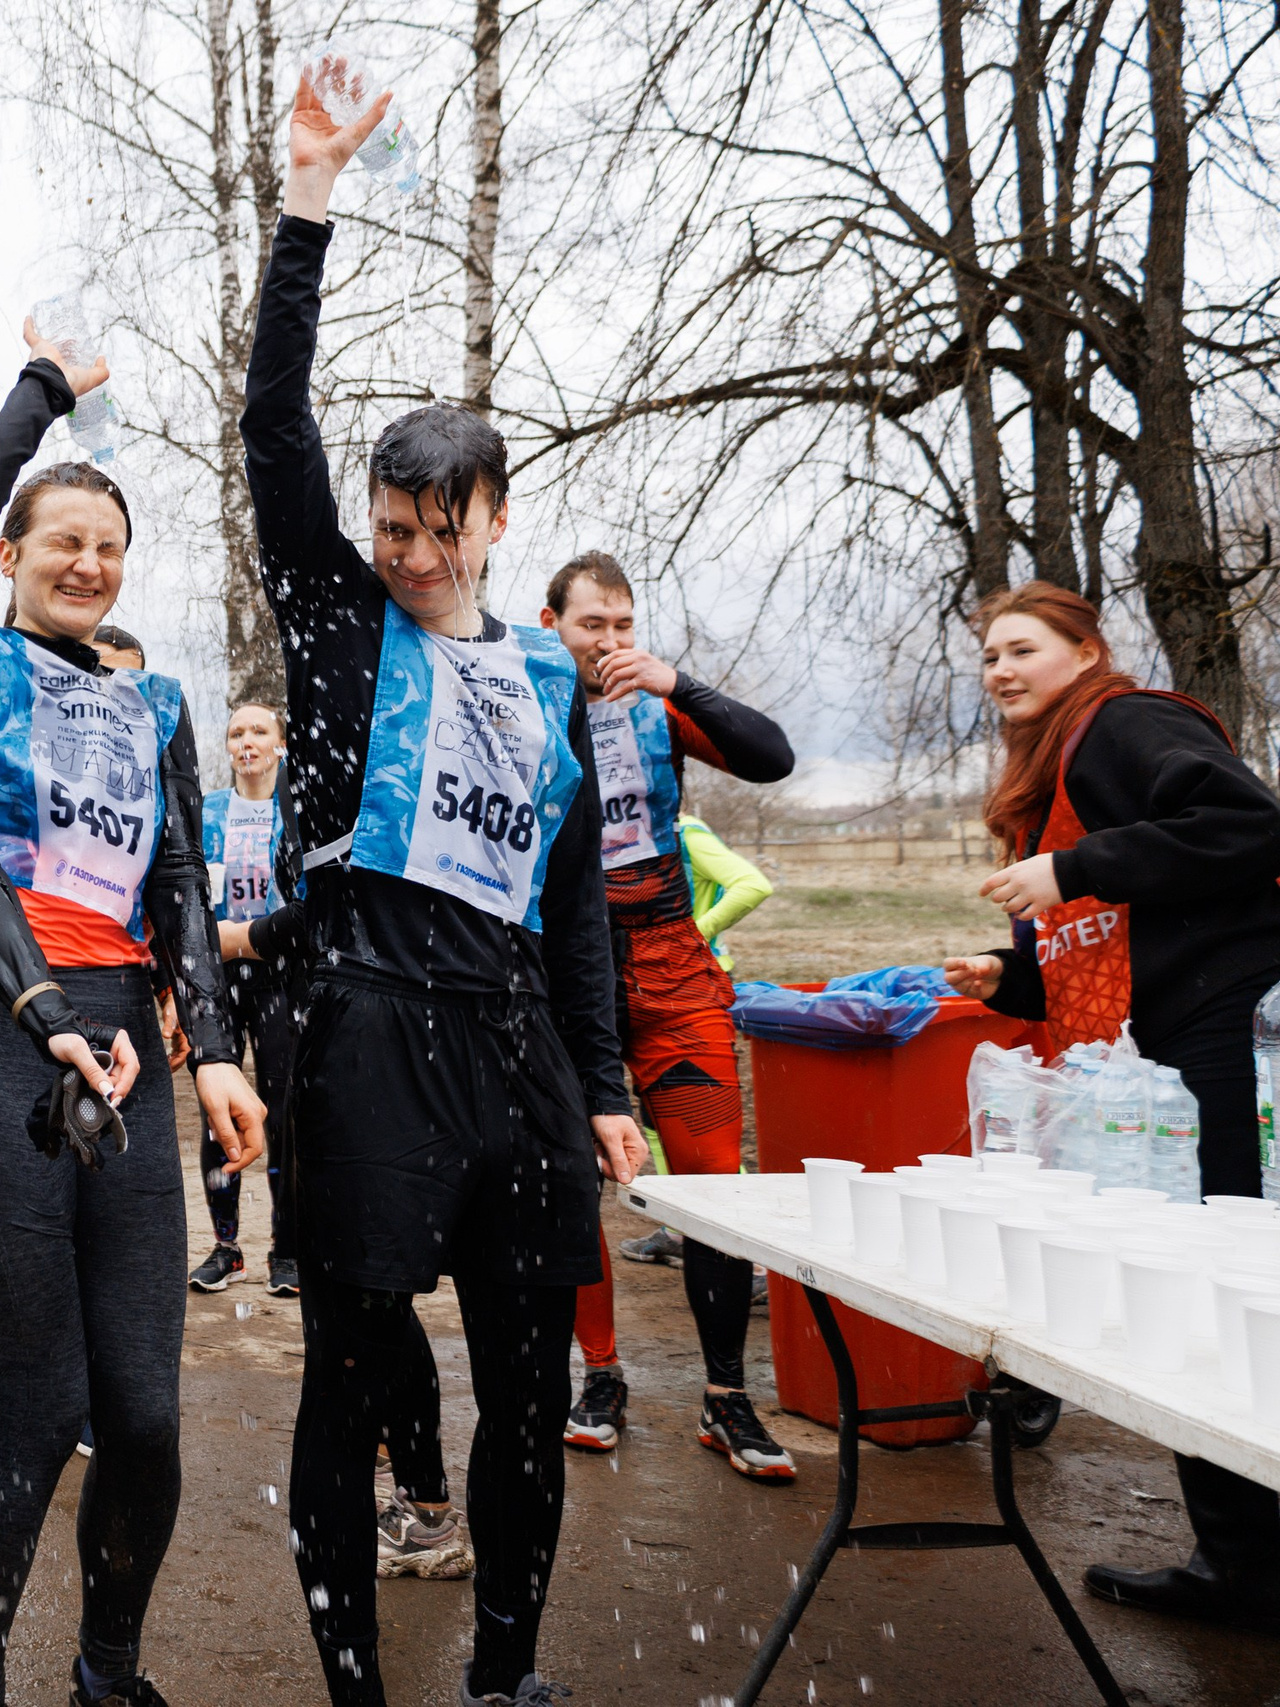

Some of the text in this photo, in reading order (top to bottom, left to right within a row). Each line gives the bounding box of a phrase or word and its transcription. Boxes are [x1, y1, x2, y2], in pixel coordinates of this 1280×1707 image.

[39, 675, 92, 689] ГОНКА
[478, 676, 529, 696] ЕРОЕВ
[56, 700, 133, 735] Sminex
[455, 710, 476, 721] FINE
[57, 735, 78, 744] FINE
[593, 736, 618, 750] nex
[50, 780, 143, 856] 5407
[230, 816, 273, 825] ГОНКА ГЕР
[432, 770, 535, 854] 5408
[602, 793, 641, 828] 02
[69, 865, 126, 897] ГАЗПРОМБАНК
[232, 878, 269, 900] 518
[456, 863, 509, 893] ГАЗПРОМБАНК
